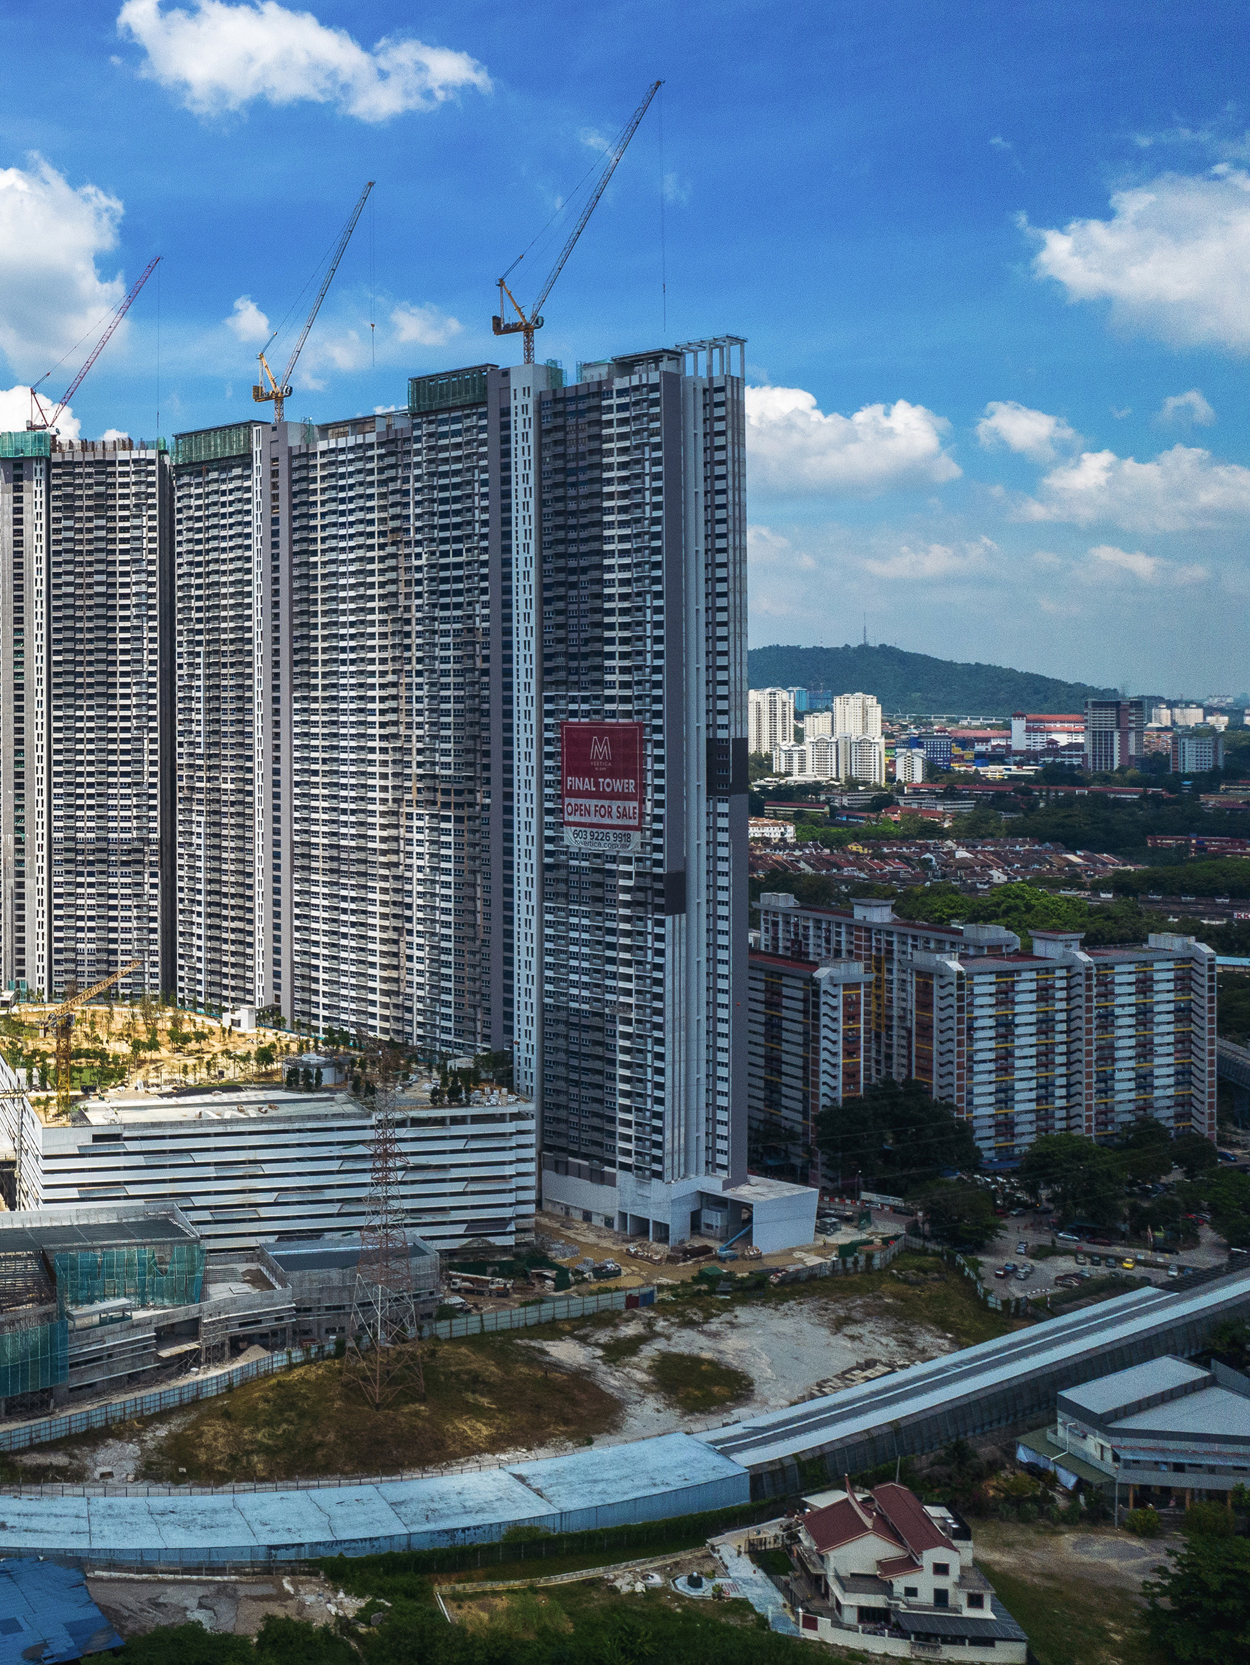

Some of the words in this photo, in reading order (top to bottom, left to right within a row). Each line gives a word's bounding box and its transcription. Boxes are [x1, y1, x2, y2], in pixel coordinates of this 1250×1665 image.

[567, 776, 596, 791] FINAL
[598, 778, 636, 793] TOWER
[566, 802, 591, 818] OPEN
[594, 804, 613, 819] FOR
[616, 805, 637, 820] SALE
[573, 829, 588, 840] 603
[590, 830, 611, 842] 9226
[612, 832, 632, 843] 9918
